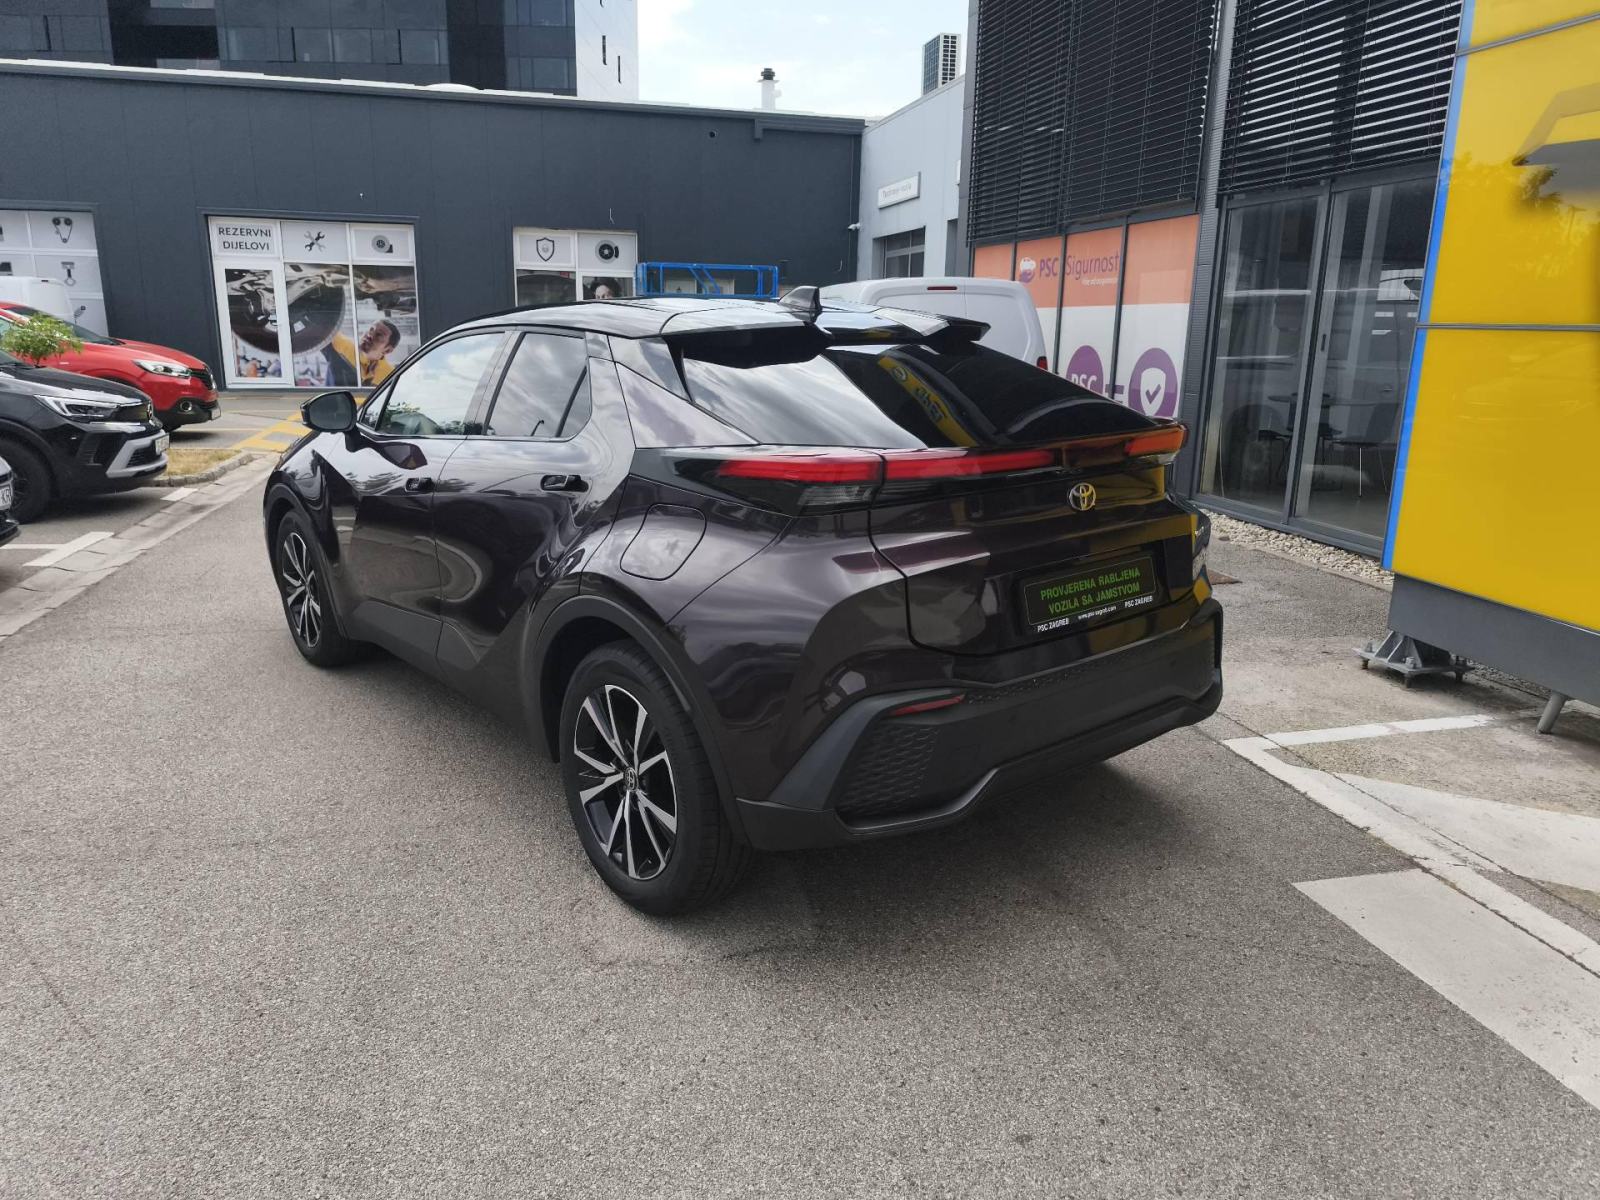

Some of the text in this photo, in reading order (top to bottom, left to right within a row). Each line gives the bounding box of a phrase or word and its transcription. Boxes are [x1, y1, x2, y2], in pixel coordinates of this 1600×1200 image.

[218, 227, 271, 237] REZERVNI
[223, 241, 270, 250] DIJELOVI
[1039, 250, 1120, 280] PSC Sigurnost
[1040, 567, 1141, 600] PROVJERENA RABLJENA
[1048, 582, 1141, 614] VOZILA SA JAMSTVOM
[1124, 600, 1135, 608] PSC
[1037, 623, 1049, 633] PSC
